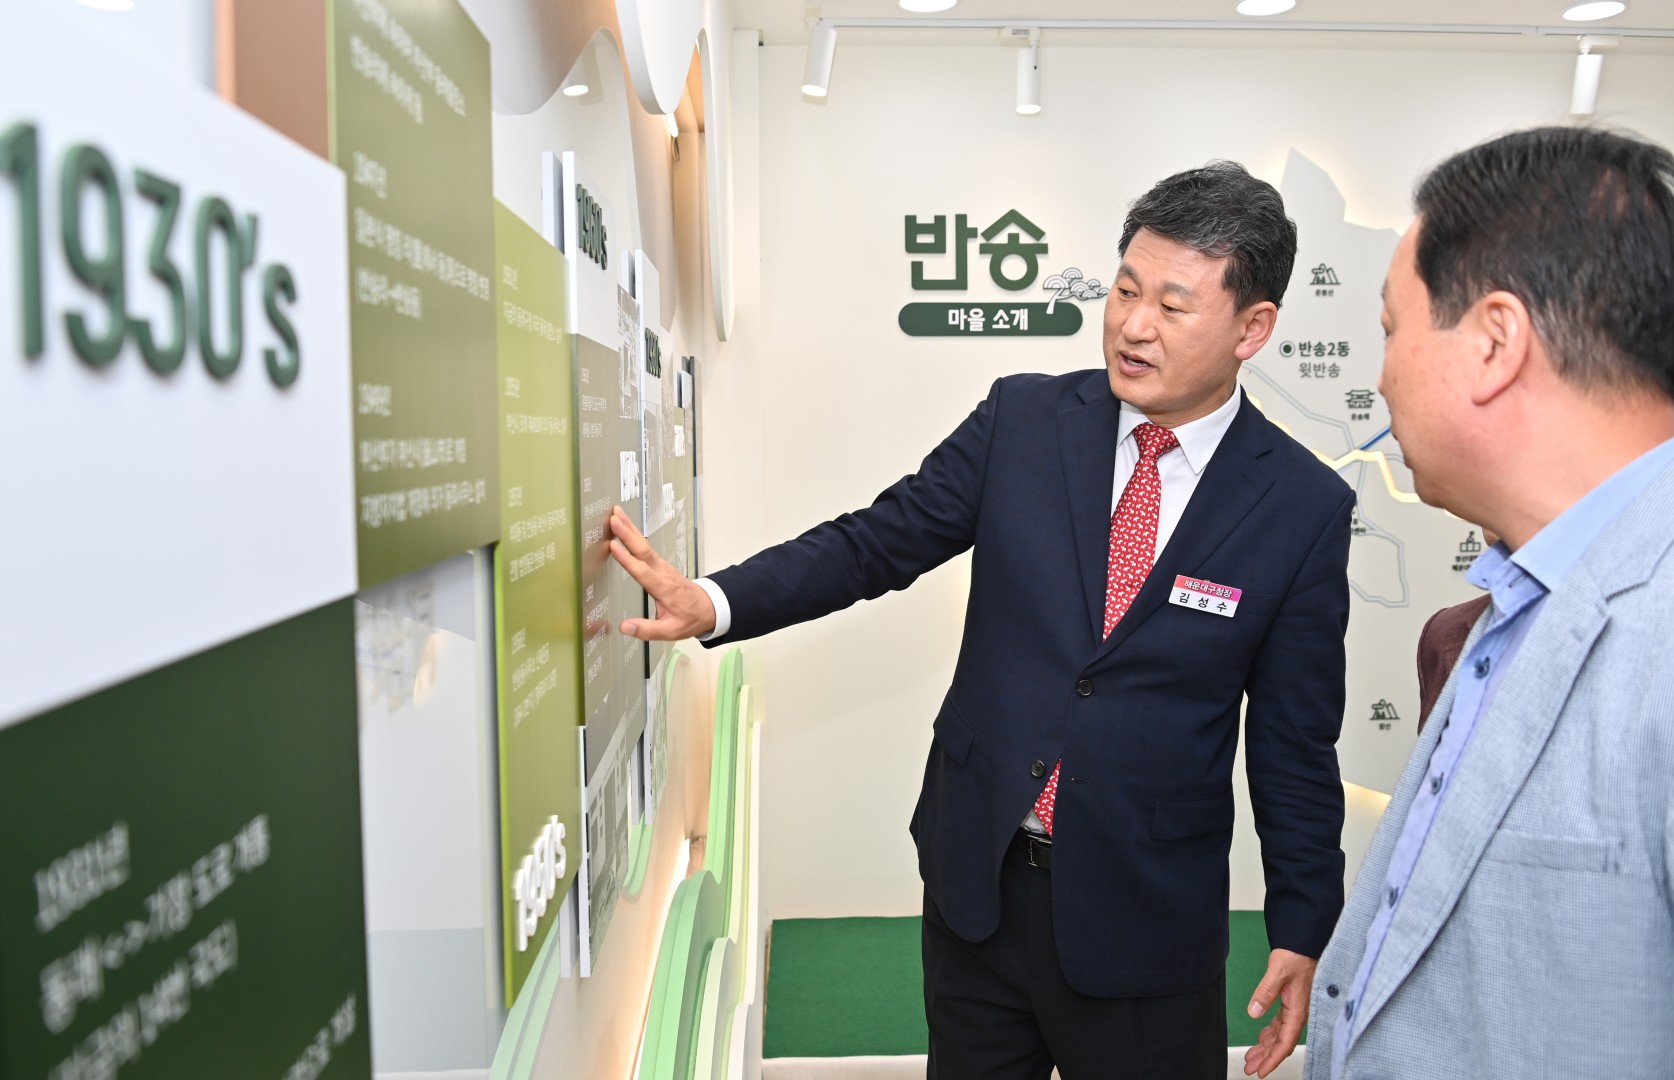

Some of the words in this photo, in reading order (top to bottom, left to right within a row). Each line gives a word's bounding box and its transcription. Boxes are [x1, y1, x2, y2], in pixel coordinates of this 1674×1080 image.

[575, 183, 608, 270] 1960's
[0, 119, 300, 391] 1930's
[904, 208, 1049, 291] 반송
[948, 307, 986, 332] 마을
[992, 308, 1029, 331] 소개
[1298, 340, 1350, 358] 반송2동
[1298, 361, 1341, 379] 윗반송
[1184, 579, 1233, 598] 해운대구청장
